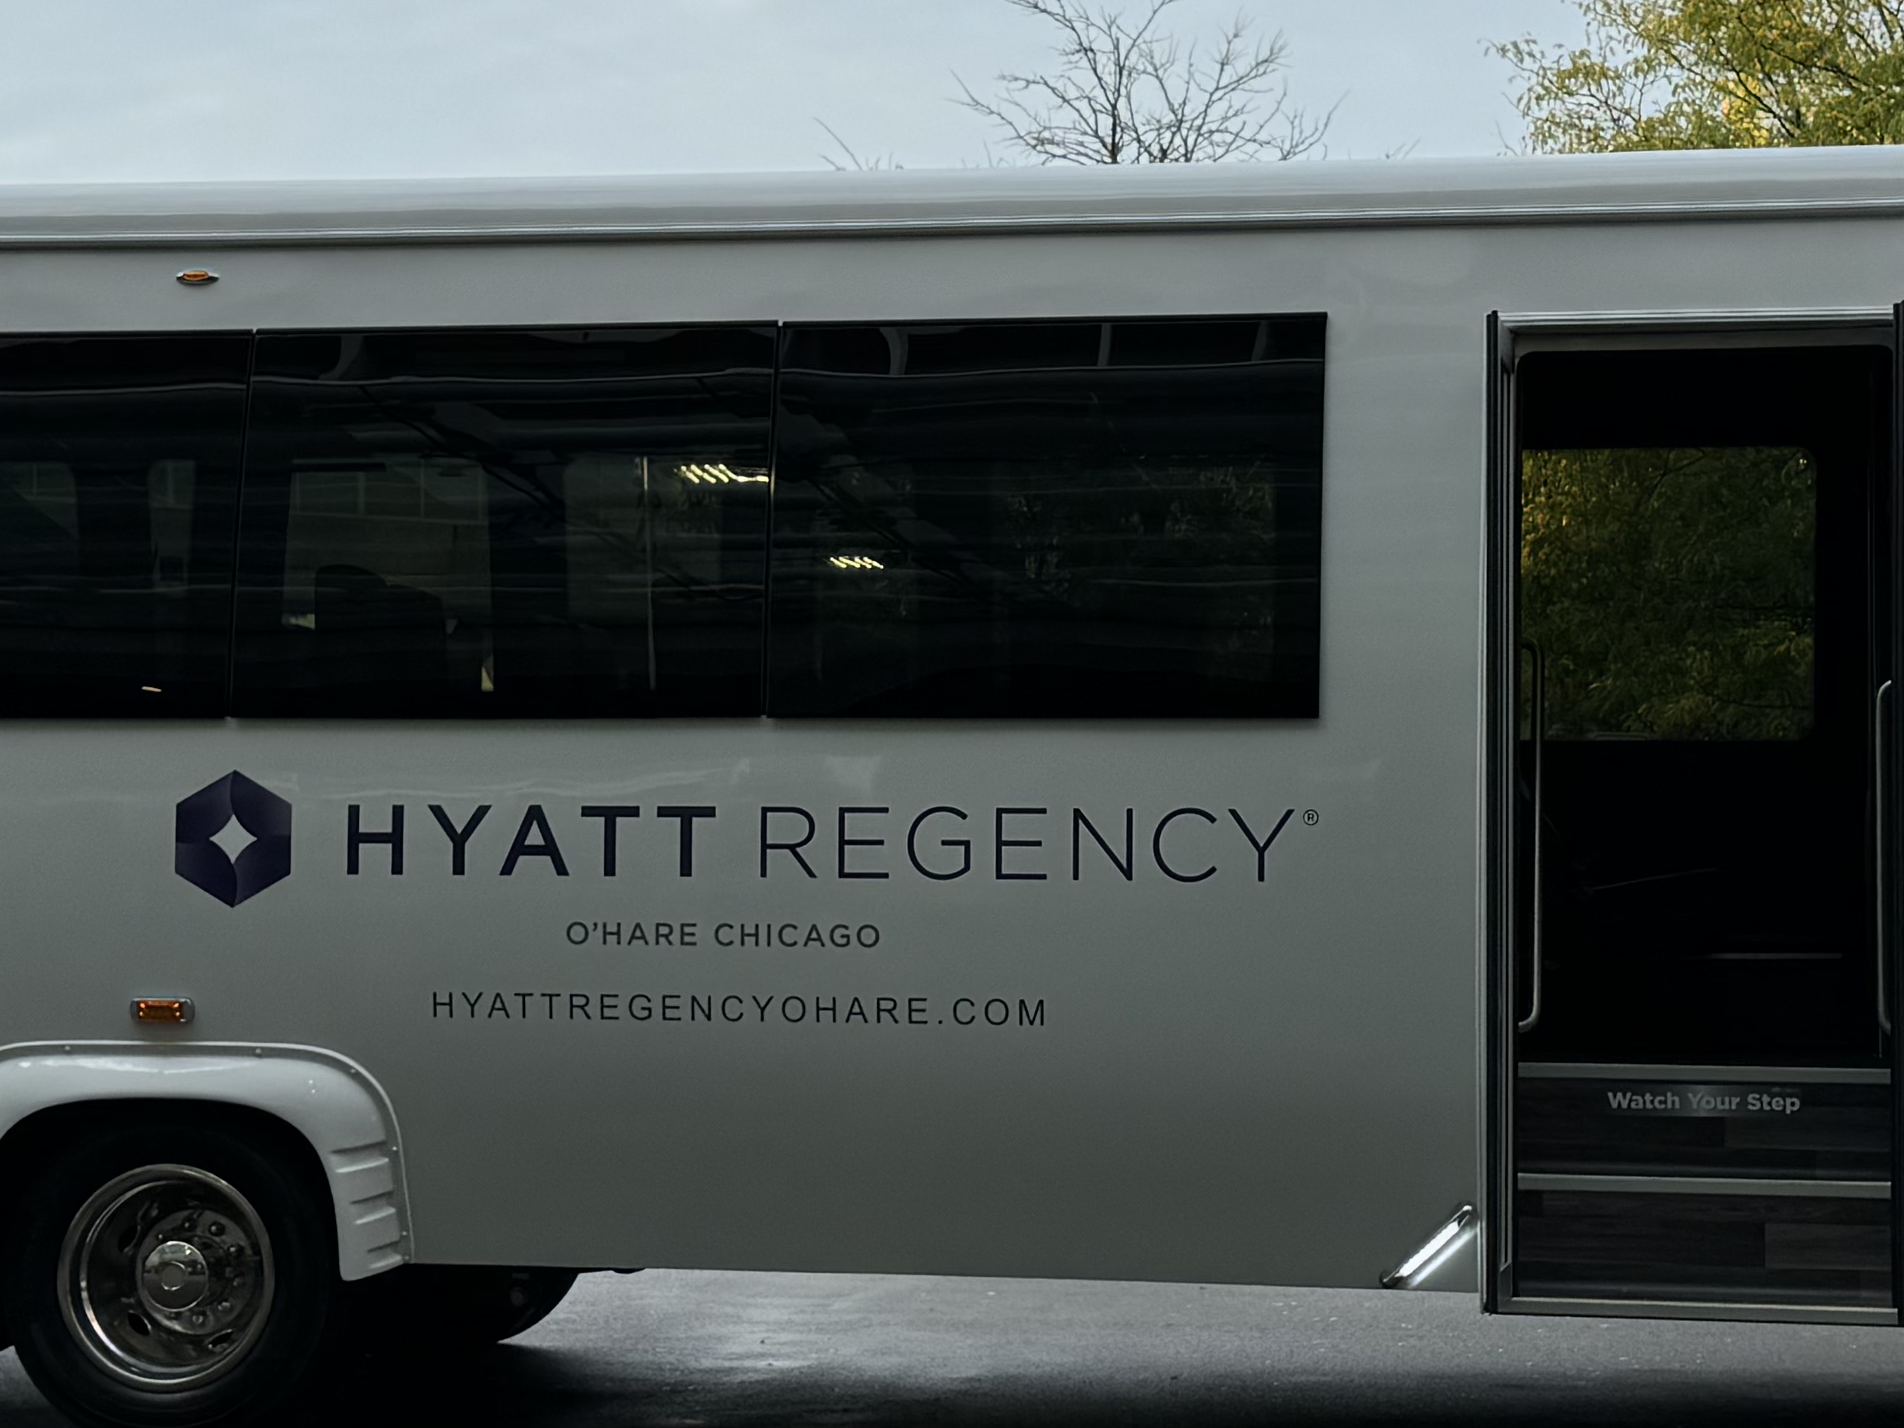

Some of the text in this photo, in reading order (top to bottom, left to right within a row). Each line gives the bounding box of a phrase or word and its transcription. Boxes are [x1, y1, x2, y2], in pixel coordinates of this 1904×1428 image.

[346, 804, 718, 877] HYATT
[565, 921, 881, 948] O'HARE CHICAGO
[432, 991, 1046, 1027] HYATTREGENCYOHARE.COM
[1607, 1091, 1800, 1114] Watch Your Step
